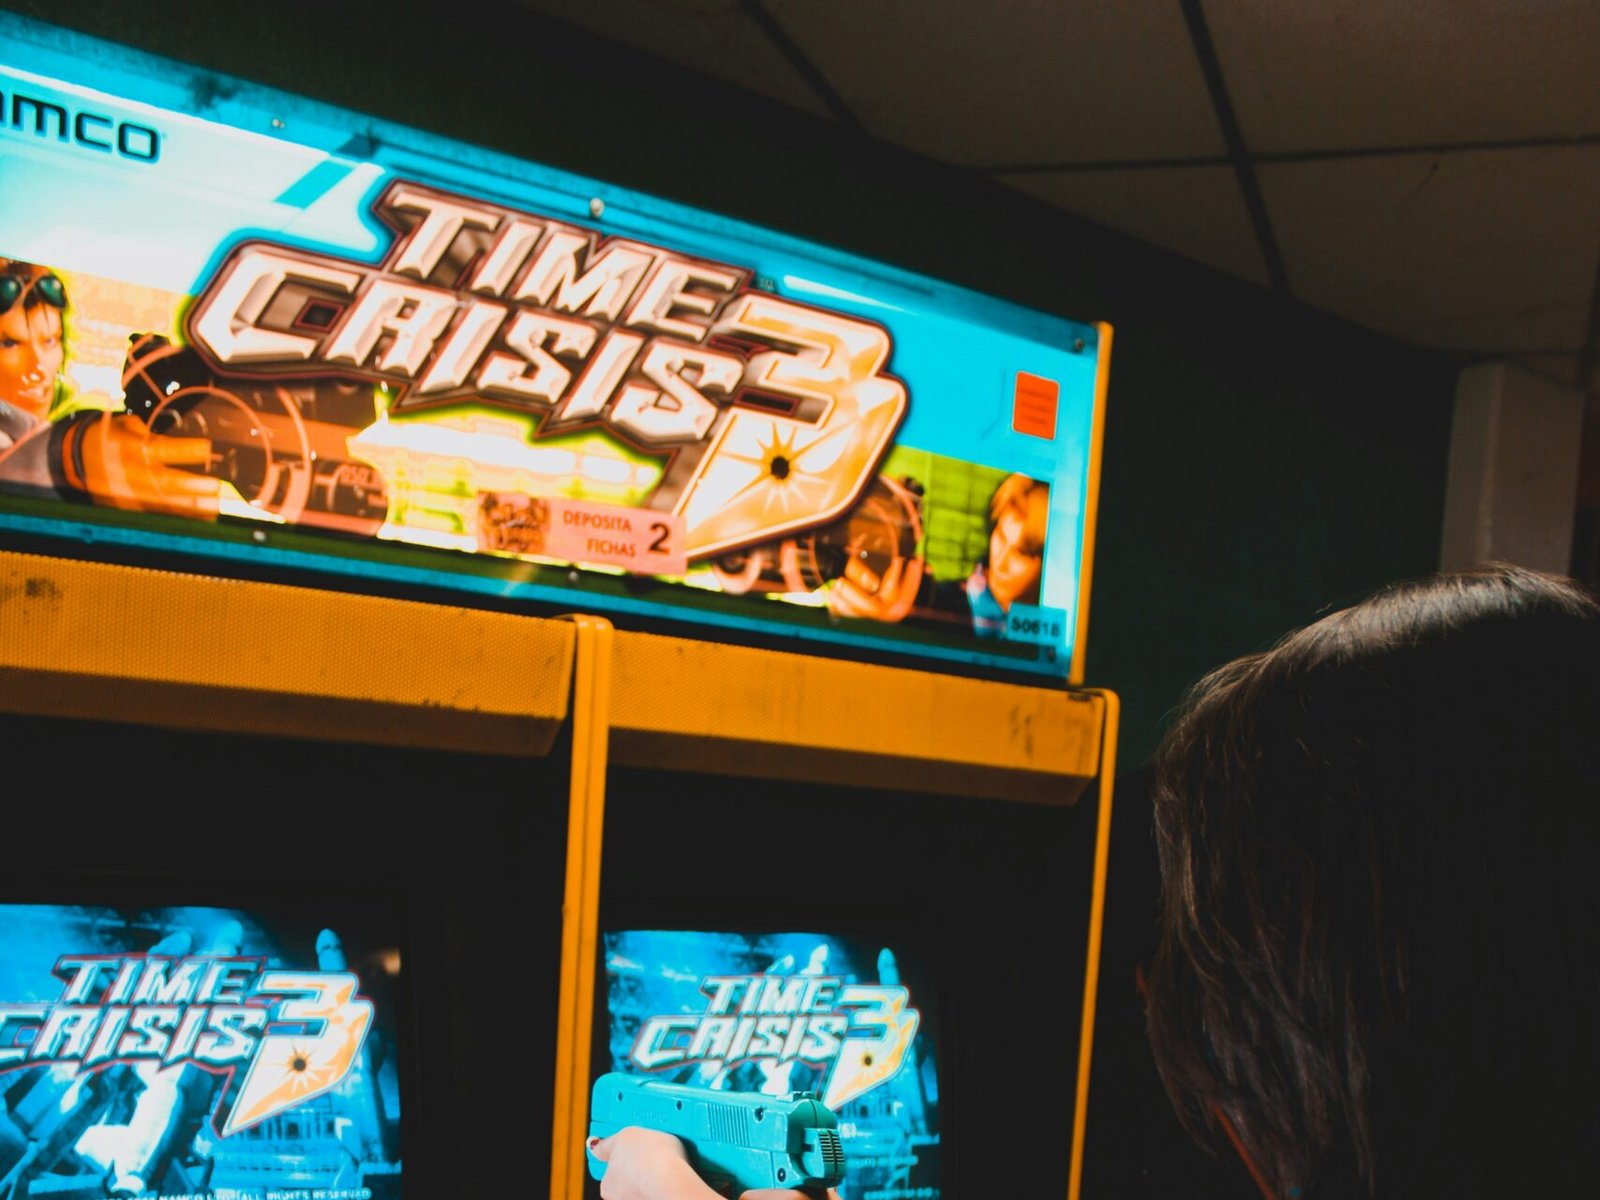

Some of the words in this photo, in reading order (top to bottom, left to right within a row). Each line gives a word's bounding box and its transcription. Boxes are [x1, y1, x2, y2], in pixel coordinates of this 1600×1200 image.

[0, 90, 159, 163] mco
[390, 188, 742, 343] TIME
[194, 248, 746, 442] CRISIS
[671, 293, 907, 558] 3
[563, 510, 632, 531] DEPOSITA
[587, 538, 636, 557] FICHAS
[648, 521, 671, 555] 2
[57, 957, 258, 1005] TIME
[702, 976, 841, 1016] TIME
[222, 970, 375, 1139] 3
[632, 1014, 849, 1070] CRISIS
[822, 985, 920, 1112] 3
